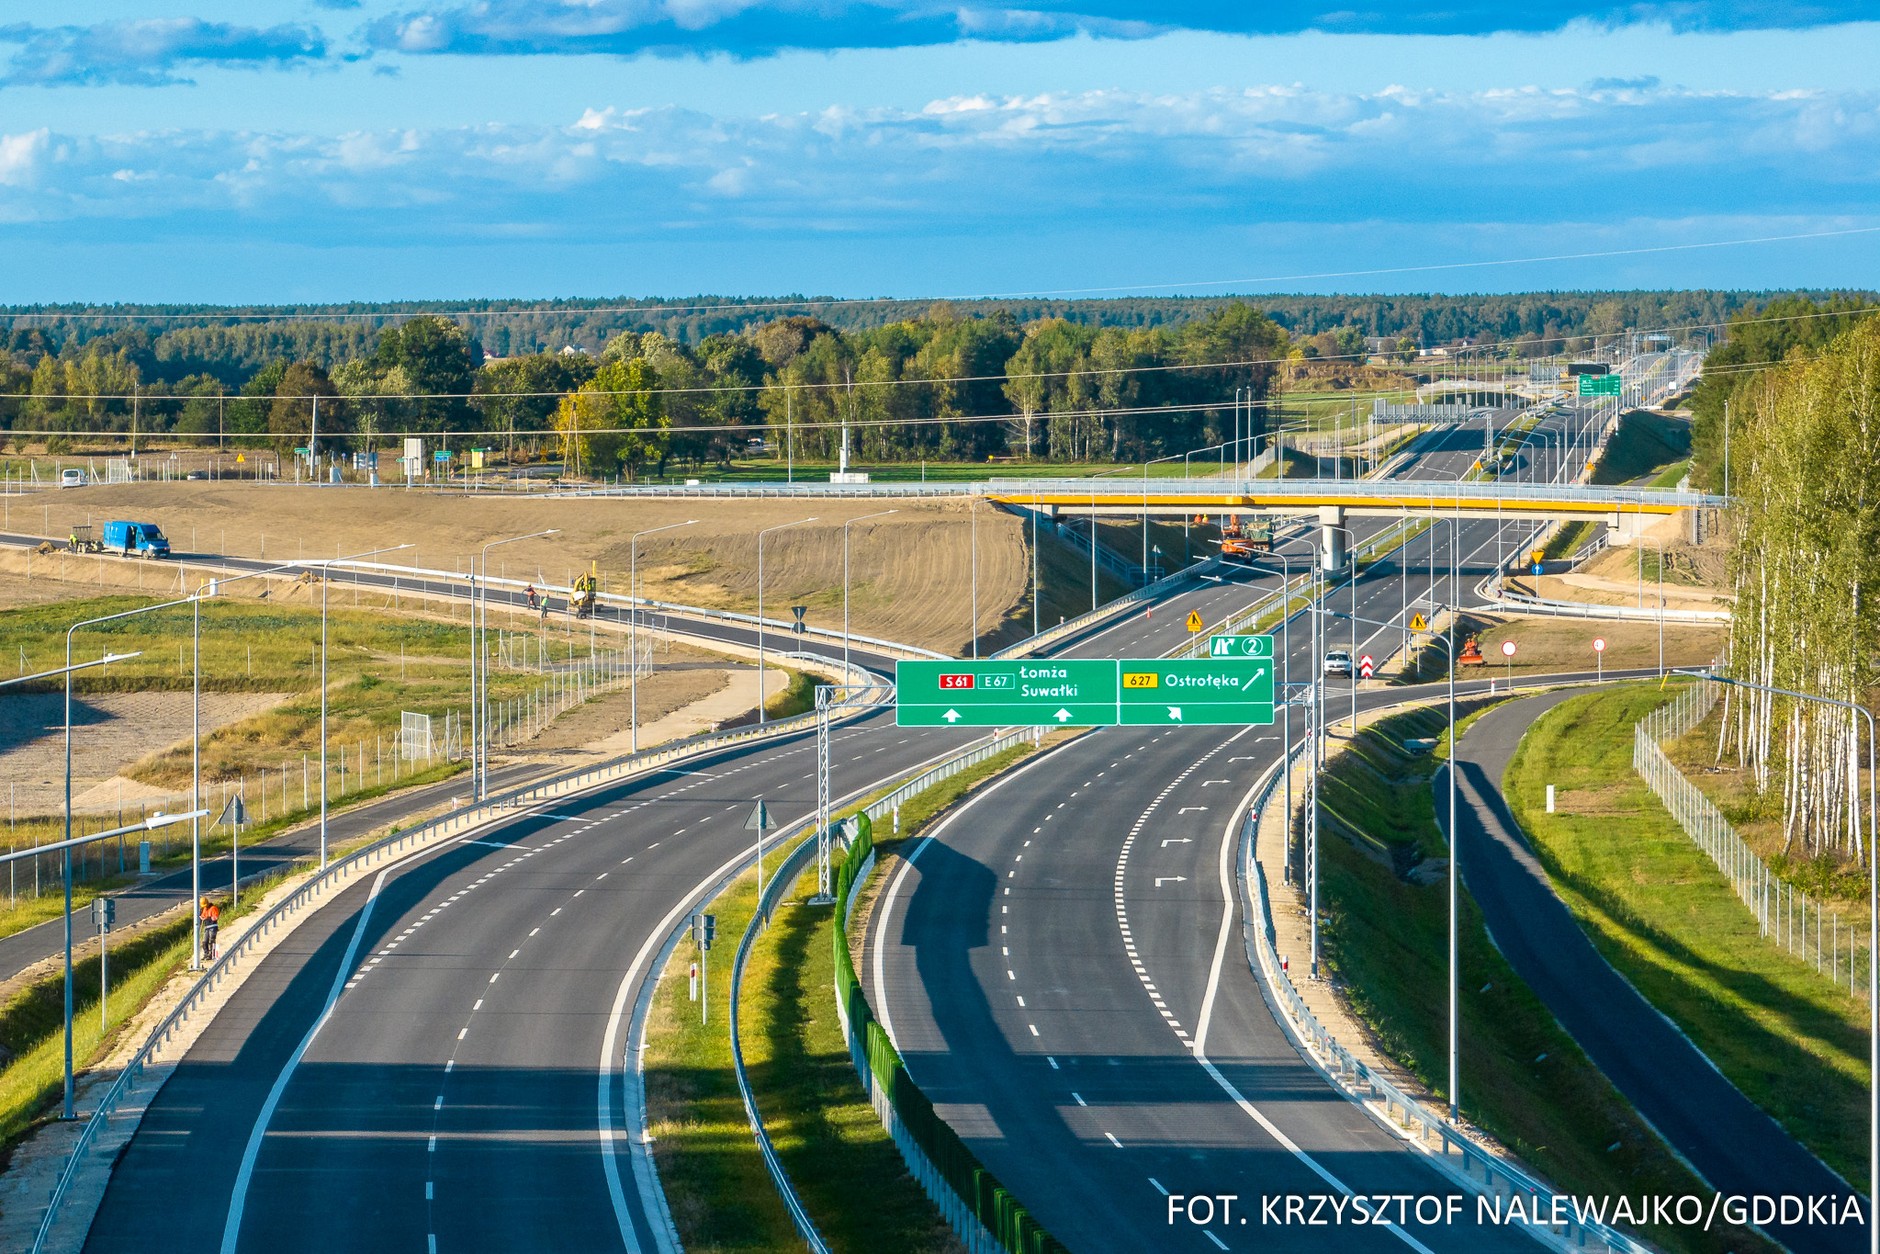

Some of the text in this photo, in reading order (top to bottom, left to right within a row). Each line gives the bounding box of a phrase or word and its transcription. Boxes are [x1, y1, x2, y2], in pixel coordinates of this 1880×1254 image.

[1247, 638, 1257, 654] 2
[1019, 666, 1067, 679] Łomża
[1130, 675, 1151, 686] 627
[1165, 673, 1239, 689] Ostrołęka
[1021, 684, 1078, 697] Suwałki
